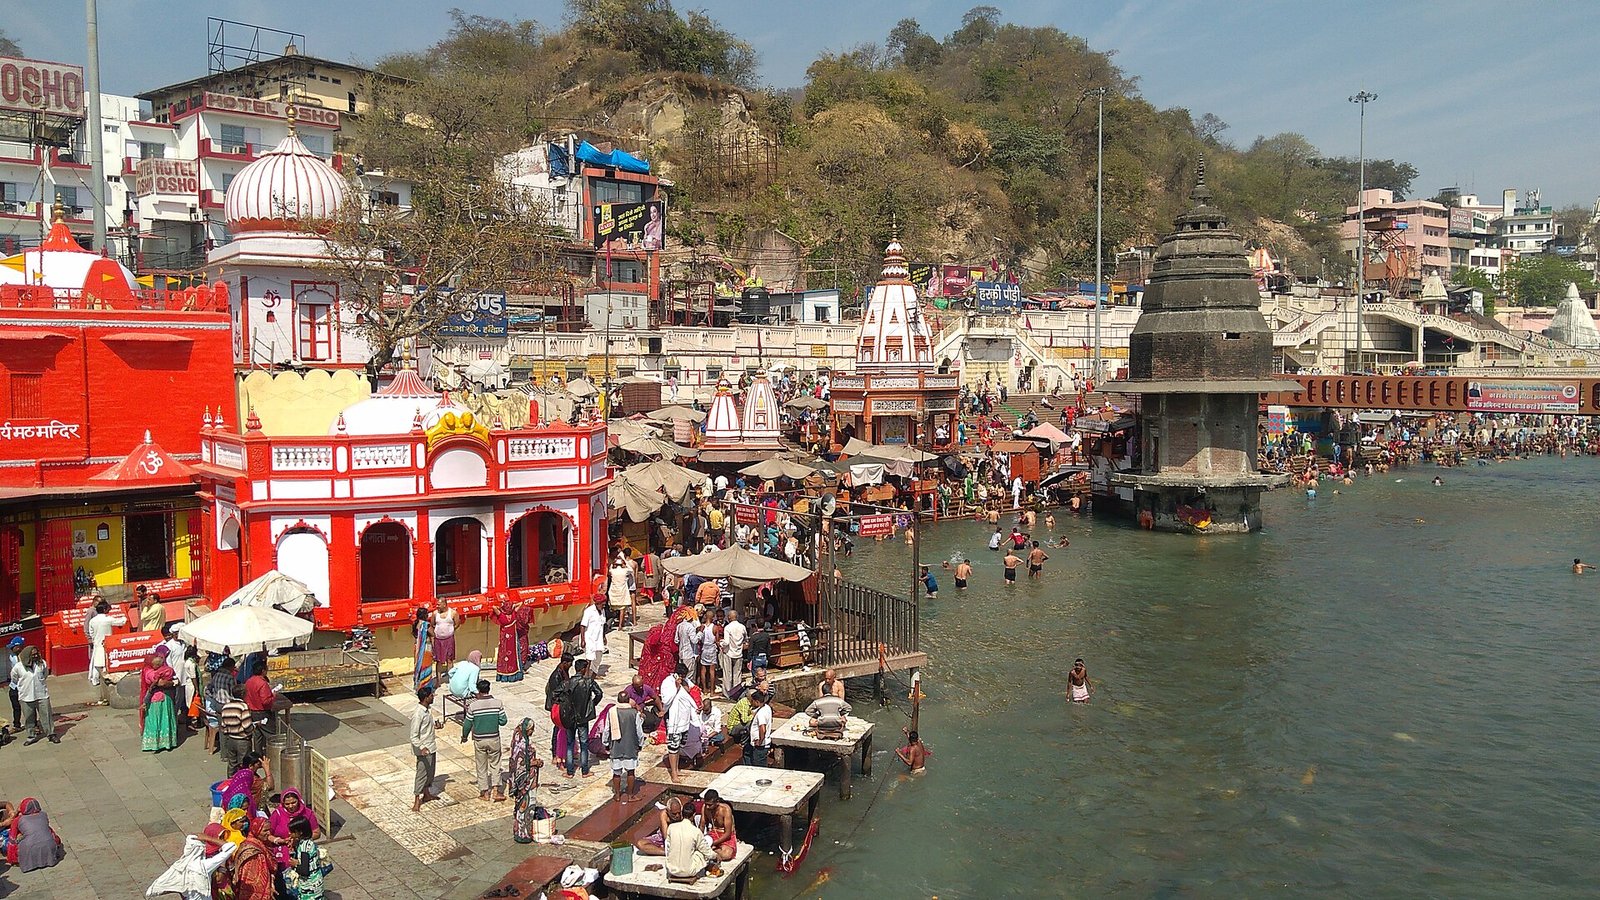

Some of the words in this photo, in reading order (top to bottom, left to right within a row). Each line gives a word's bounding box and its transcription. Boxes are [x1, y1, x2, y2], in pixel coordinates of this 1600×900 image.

[1, 63, 81, 110] OSHO
[207, 94, 279, 115] HOTEL
[155, 160, 196, 176] HOTEL
[156, 176, 197, 193] OSHO
[1451, 214, 1472, 224] GANGA
[35, 420, 80, 440] मन्दिर
